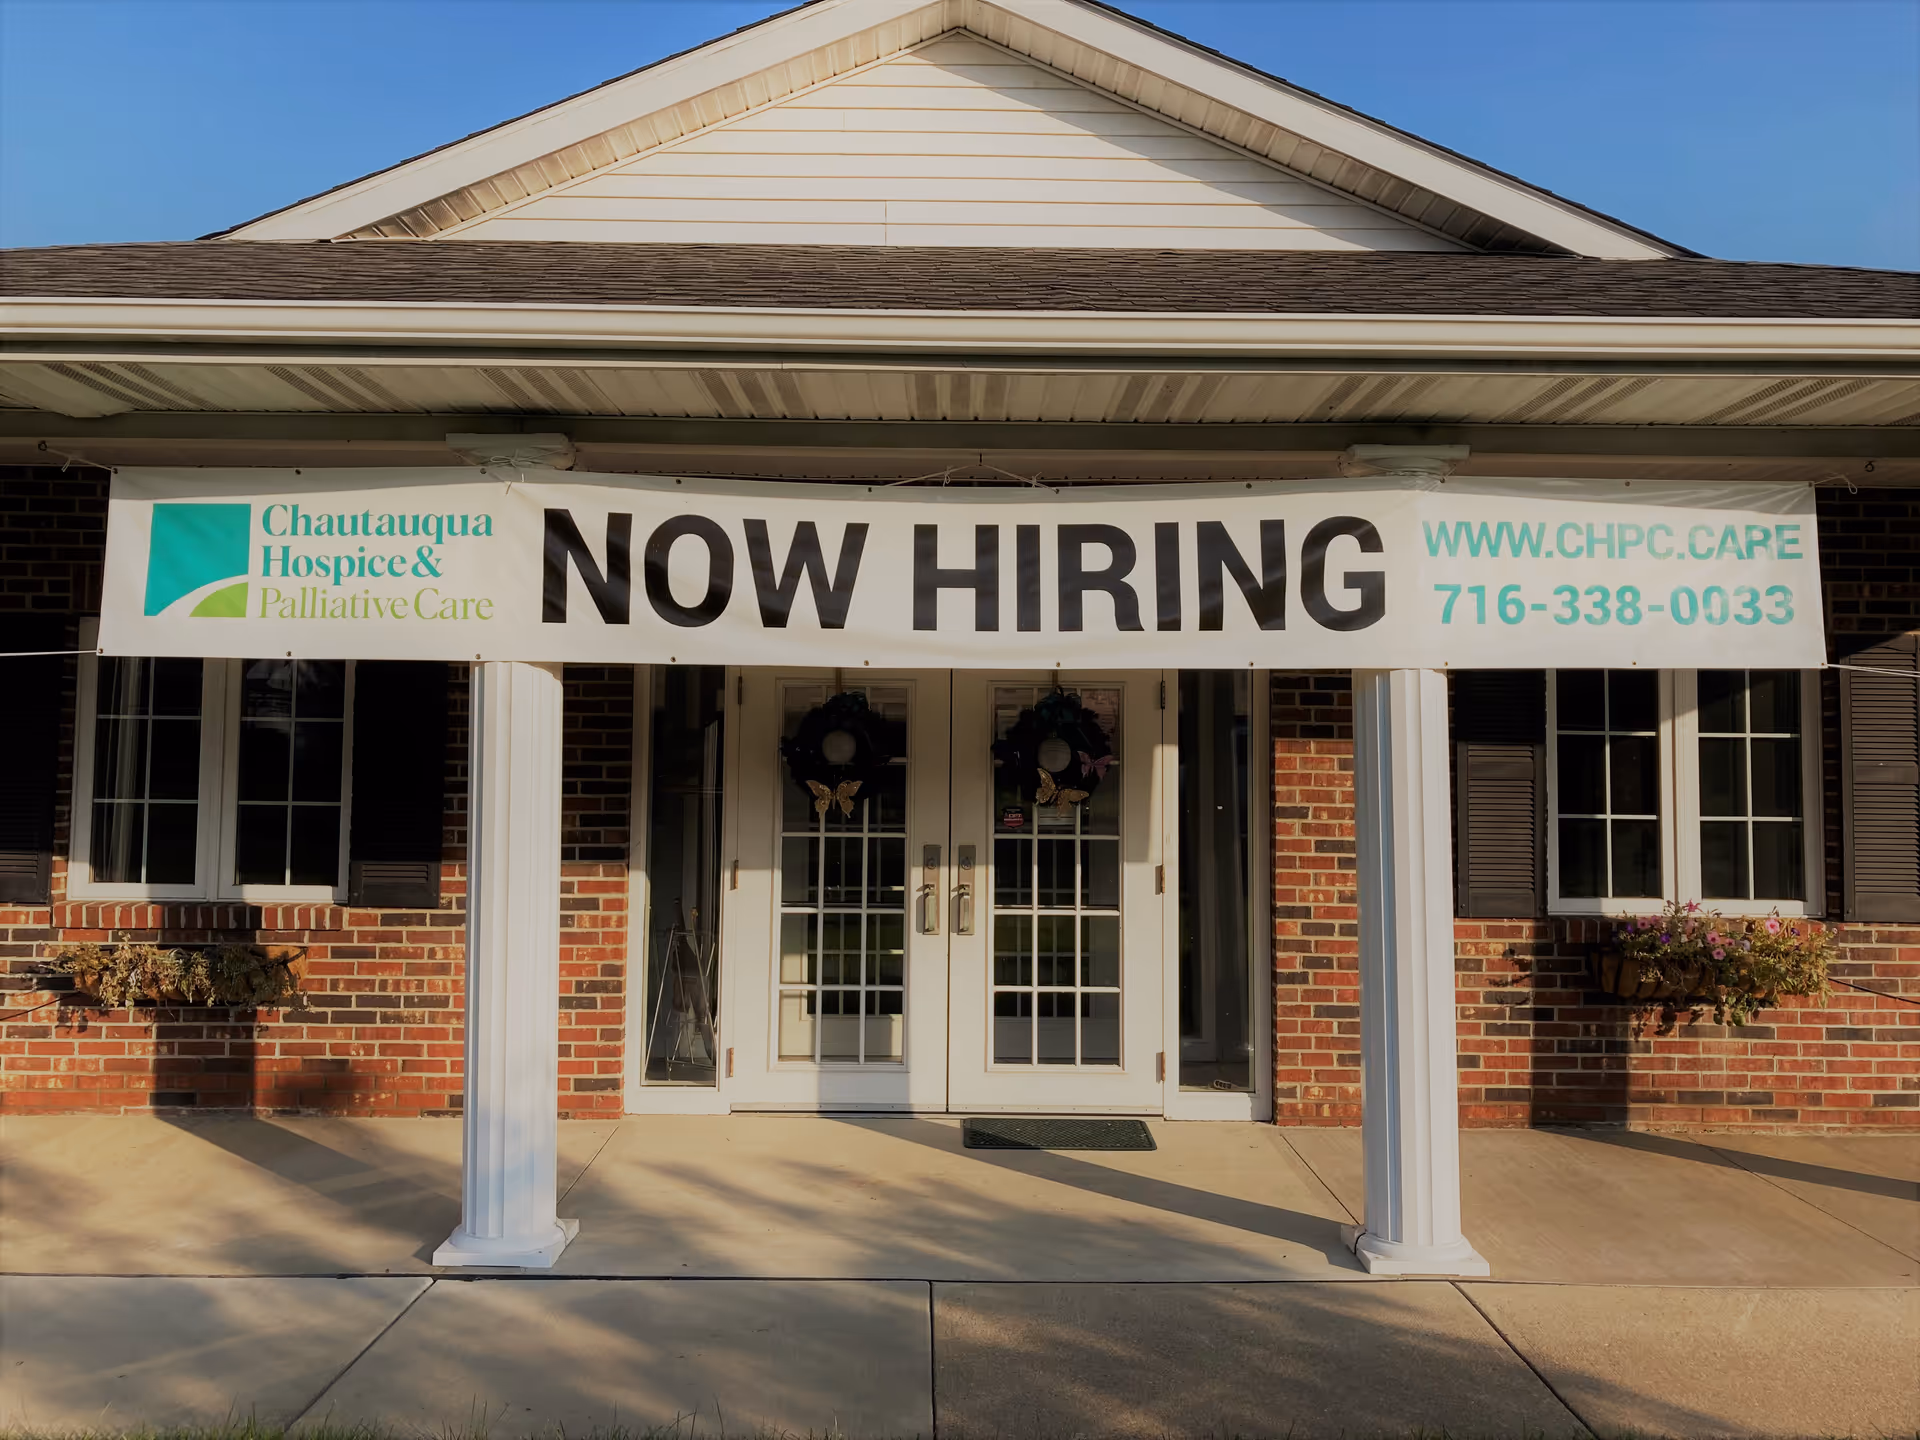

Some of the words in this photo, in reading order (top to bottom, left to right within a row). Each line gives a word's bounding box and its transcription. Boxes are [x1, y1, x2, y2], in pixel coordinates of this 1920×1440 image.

[262, 504, 493, 545] Chautauqua
[1422, 520, 1804, 560] WWW.CHPC.CARE
[260, 545, 407, 586] Hospice
[411, 546, 444, 578] &
[541, 508, 870, 630] NOW
[912, 515, 1386, 632] HIRING
[258, 586, 409, 619] Palliative
[413, 588, 494, 620] Care
[1434, 583, 1795, 626] 716-338-0033
